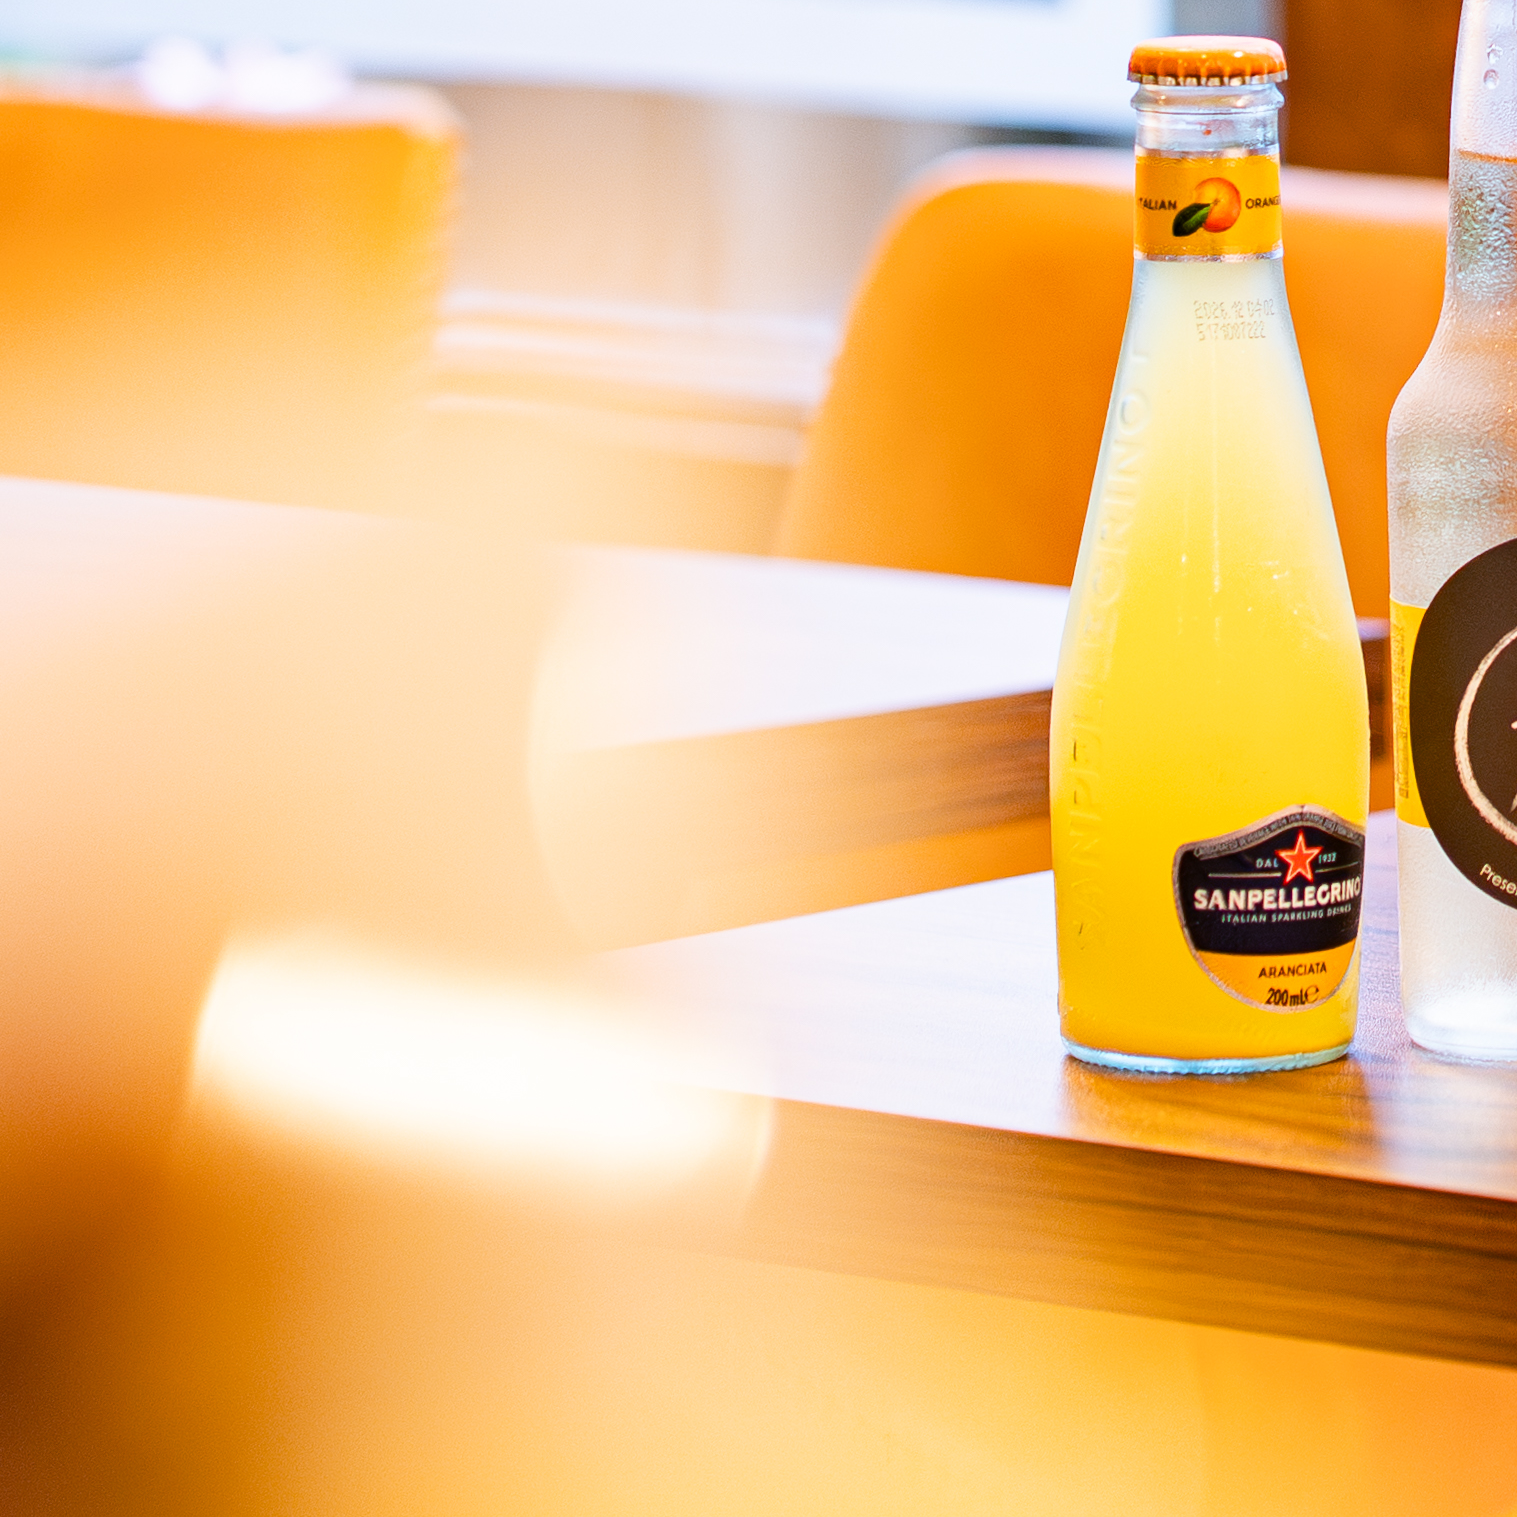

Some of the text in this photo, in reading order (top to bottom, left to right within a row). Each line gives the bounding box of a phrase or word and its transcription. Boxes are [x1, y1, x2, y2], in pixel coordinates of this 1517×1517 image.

[1256, 858, 1278, 868] DAL
[1194, 876, 1361, 910] SANPELLEGRINO
[1222, 913, 1266, 923] ITALIAN
[1272, 909, 1323, 922] SPARKLING
[1258, 962, 1327, 978] ARANCIATA
